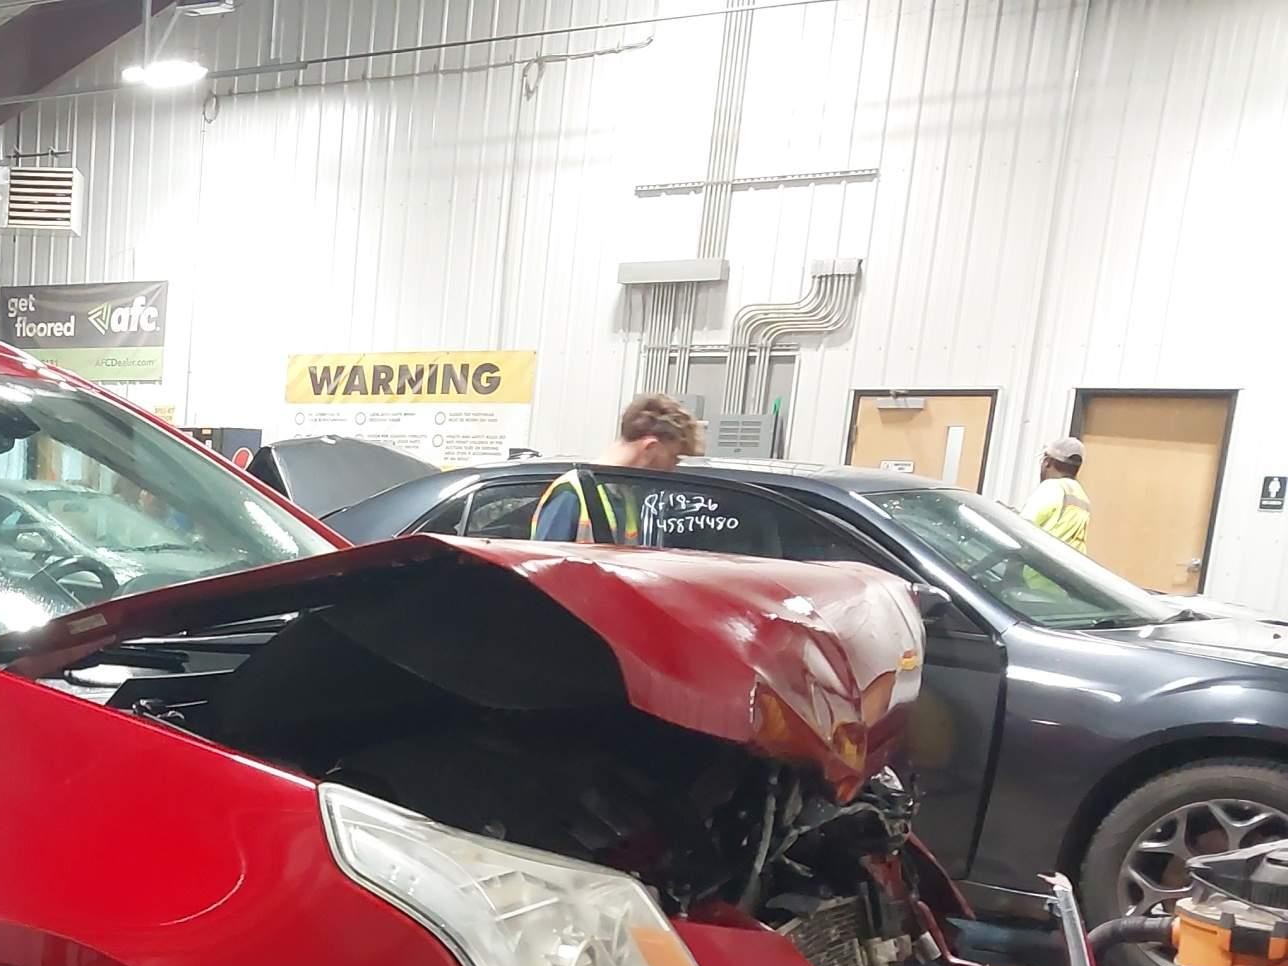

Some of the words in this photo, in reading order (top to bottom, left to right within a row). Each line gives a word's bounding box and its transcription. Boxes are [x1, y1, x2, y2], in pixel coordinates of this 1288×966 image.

[7, 294, 36, 318] get
[15, 315, 76, 338] floored
[308, 362, 502, 396] WARNING
[656, 514, 740, 534] 45874480
